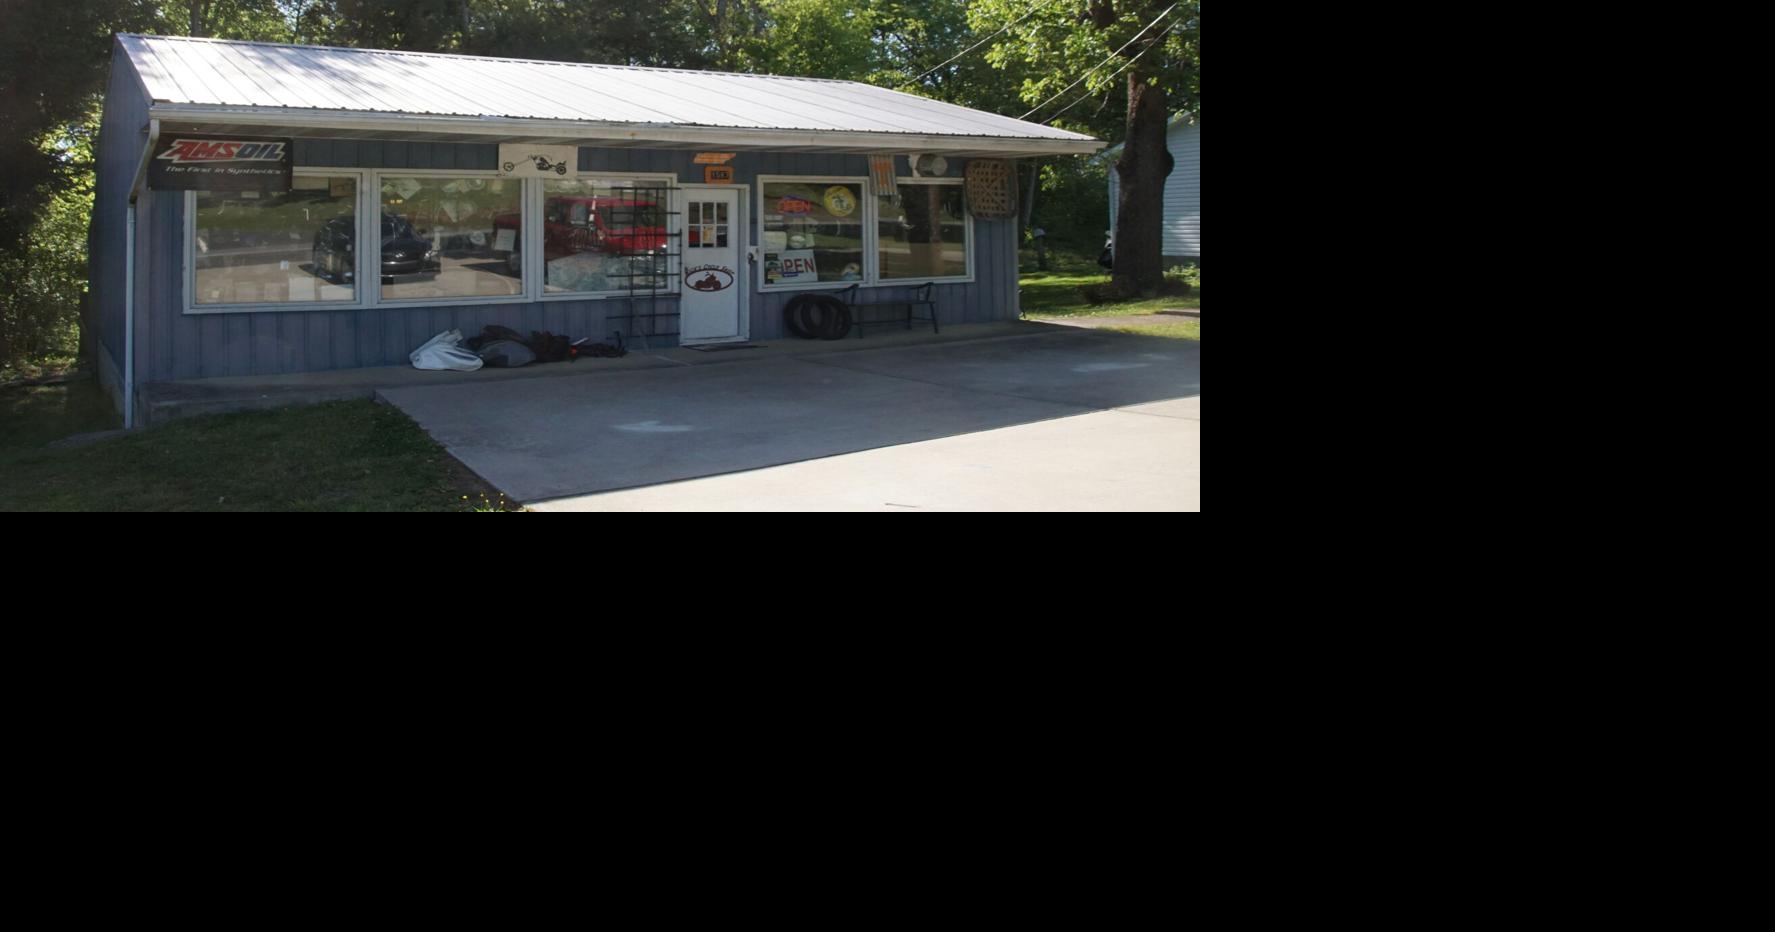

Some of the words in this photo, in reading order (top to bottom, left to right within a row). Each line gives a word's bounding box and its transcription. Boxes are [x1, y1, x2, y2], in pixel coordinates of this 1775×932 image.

[157, 139, 286, 163] AMSOIL
[226, 167, 281, 176] Synthetics
[777, 199, 811, 213] OPEN
[782, 258, 815, 274] PEN
